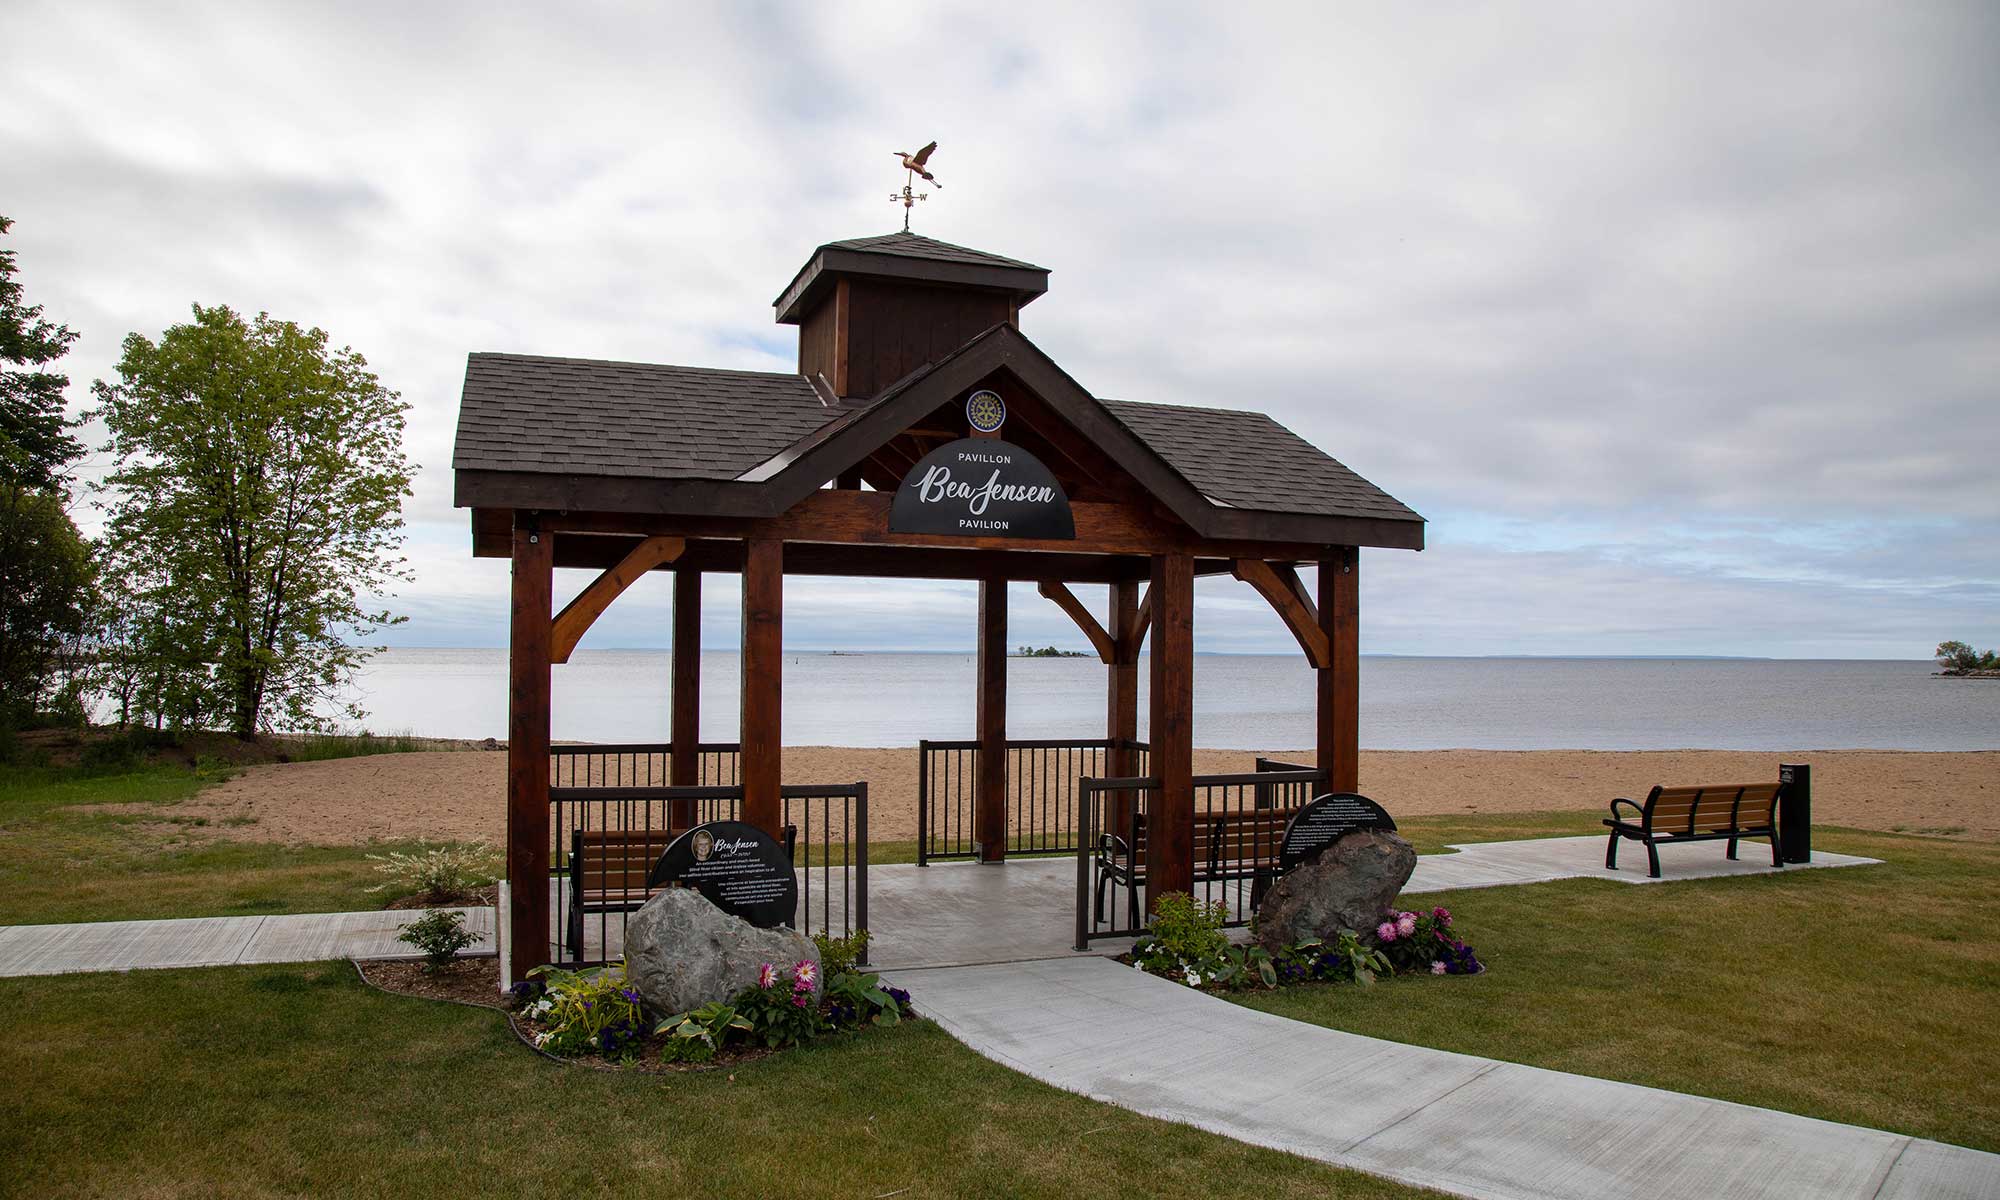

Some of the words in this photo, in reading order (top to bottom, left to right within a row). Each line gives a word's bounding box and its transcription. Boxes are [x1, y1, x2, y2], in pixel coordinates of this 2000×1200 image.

[958, 452, 1011, 464] PAVILLON
[911, 464, 976, 504] Bea
[969, 468, 1055, 515] Jensen
[959, 519, 1009, 530] PAVILION
[714, 838, 732, 852] Bea
[730, 837, 759, 854] Jensen
